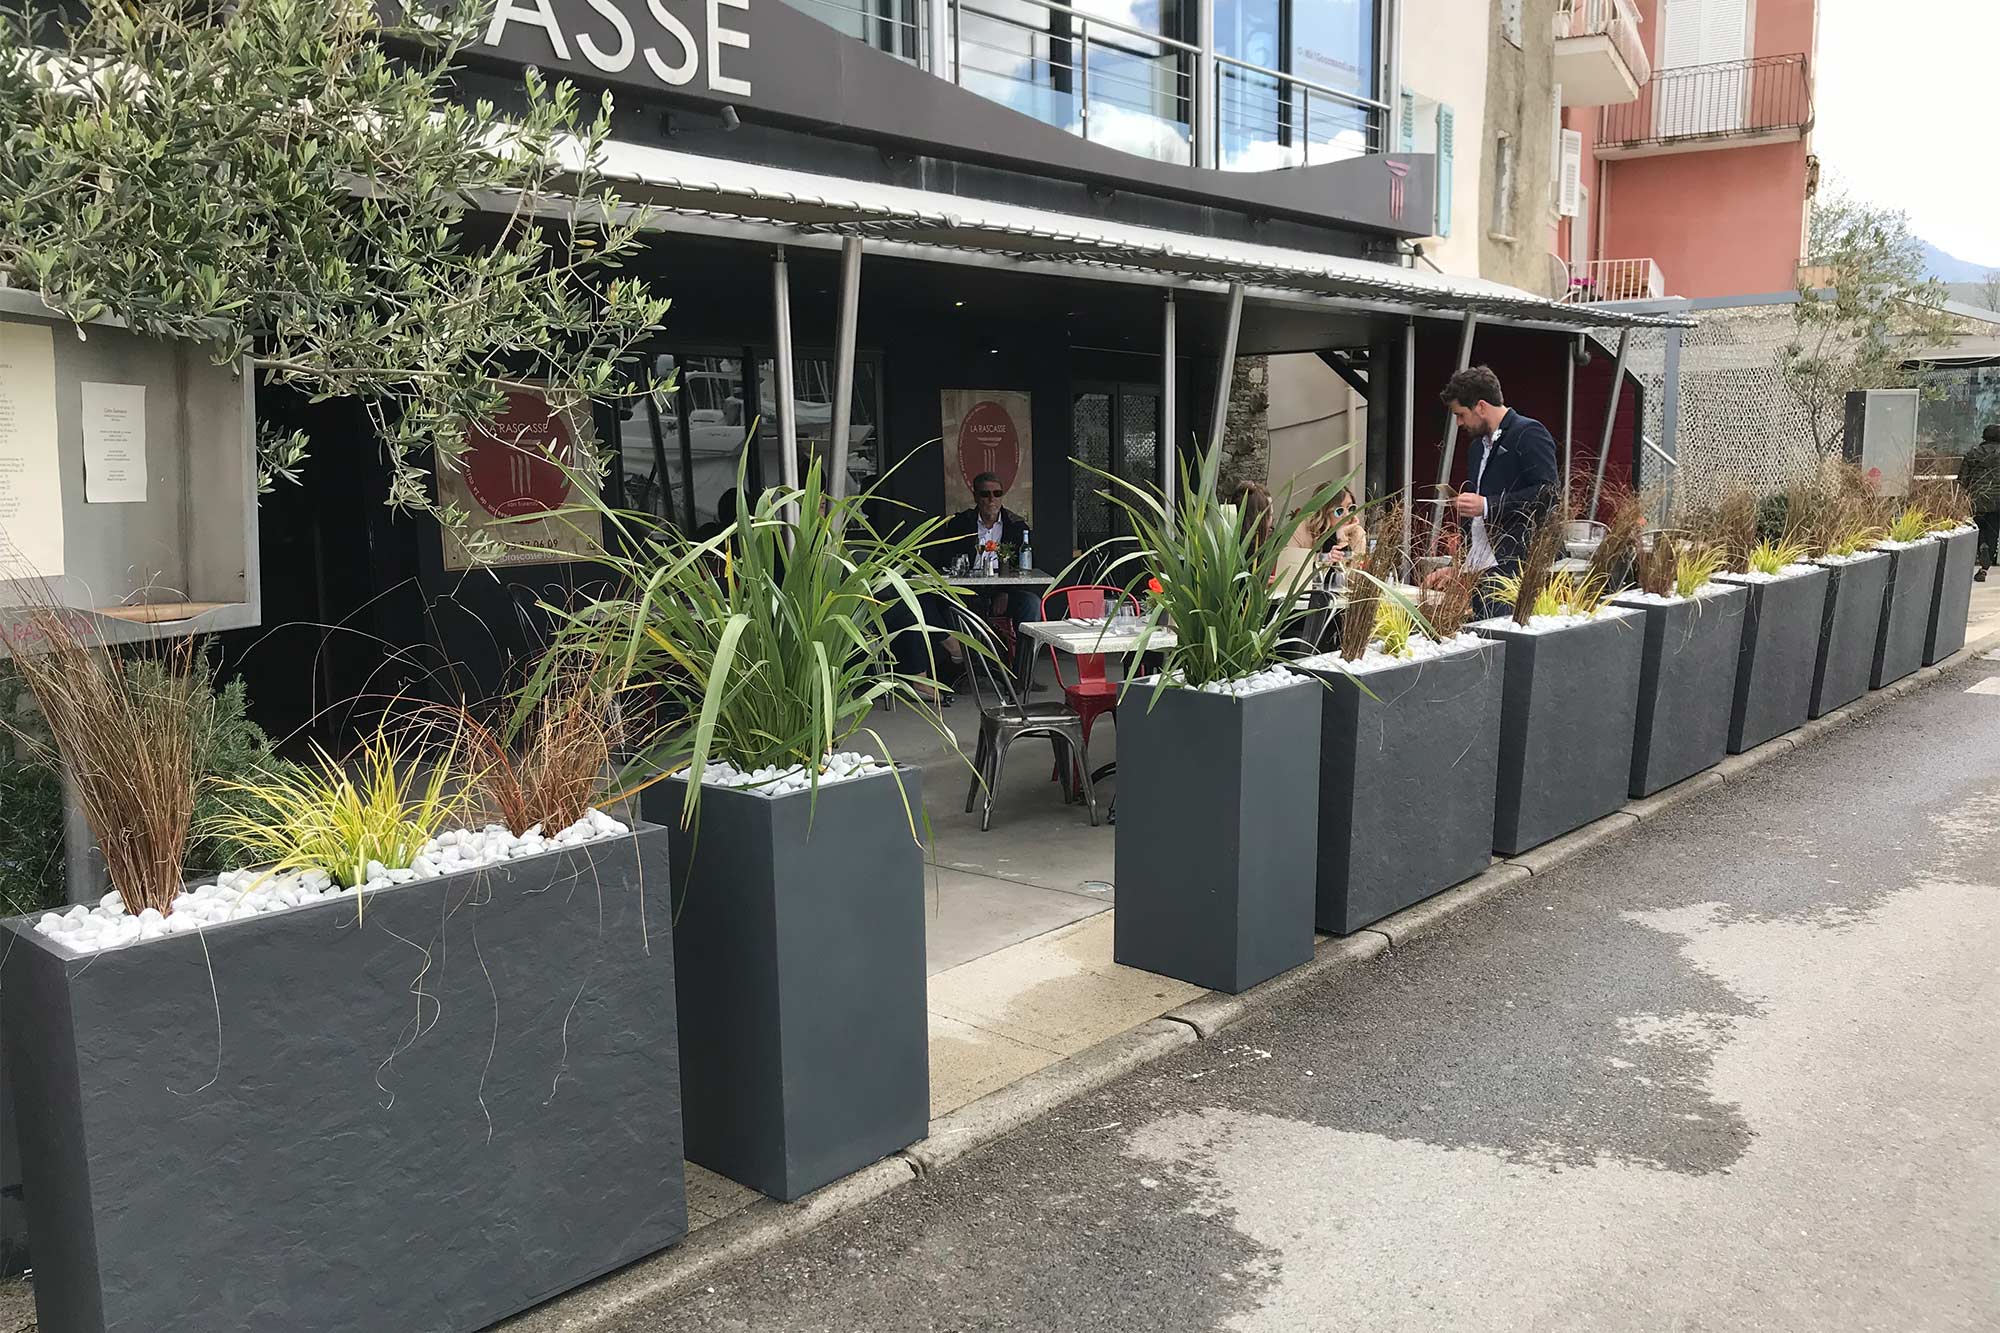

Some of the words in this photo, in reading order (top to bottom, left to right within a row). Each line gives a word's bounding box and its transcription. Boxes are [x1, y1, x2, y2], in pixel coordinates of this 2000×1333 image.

[398, 0, 751, 97] ASSE
[970, 424, 978, 433] LA
[978, 424, 1007, 433] RASCASSE
[533, 540, 545, 549] 06
[547, 539, 559, 549] 09
